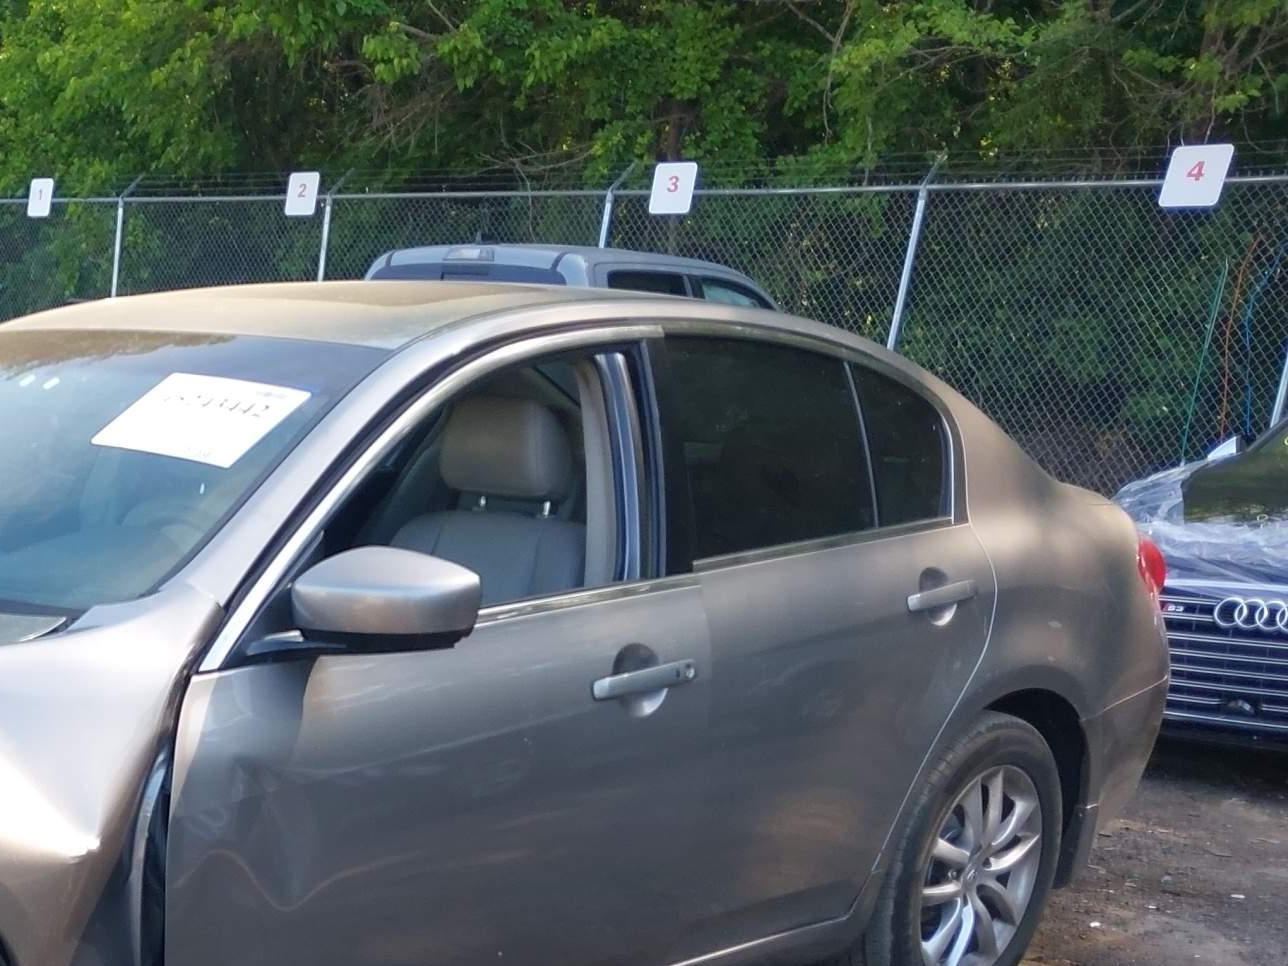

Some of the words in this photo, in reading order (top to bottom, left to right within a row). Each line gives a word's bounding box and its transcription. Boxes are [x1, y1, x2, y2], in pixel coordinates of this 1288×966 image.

[1187, 161, 1206, 182] 4
[297, 183, 307, 198] 2
[667, 175, 680, 193] 3
